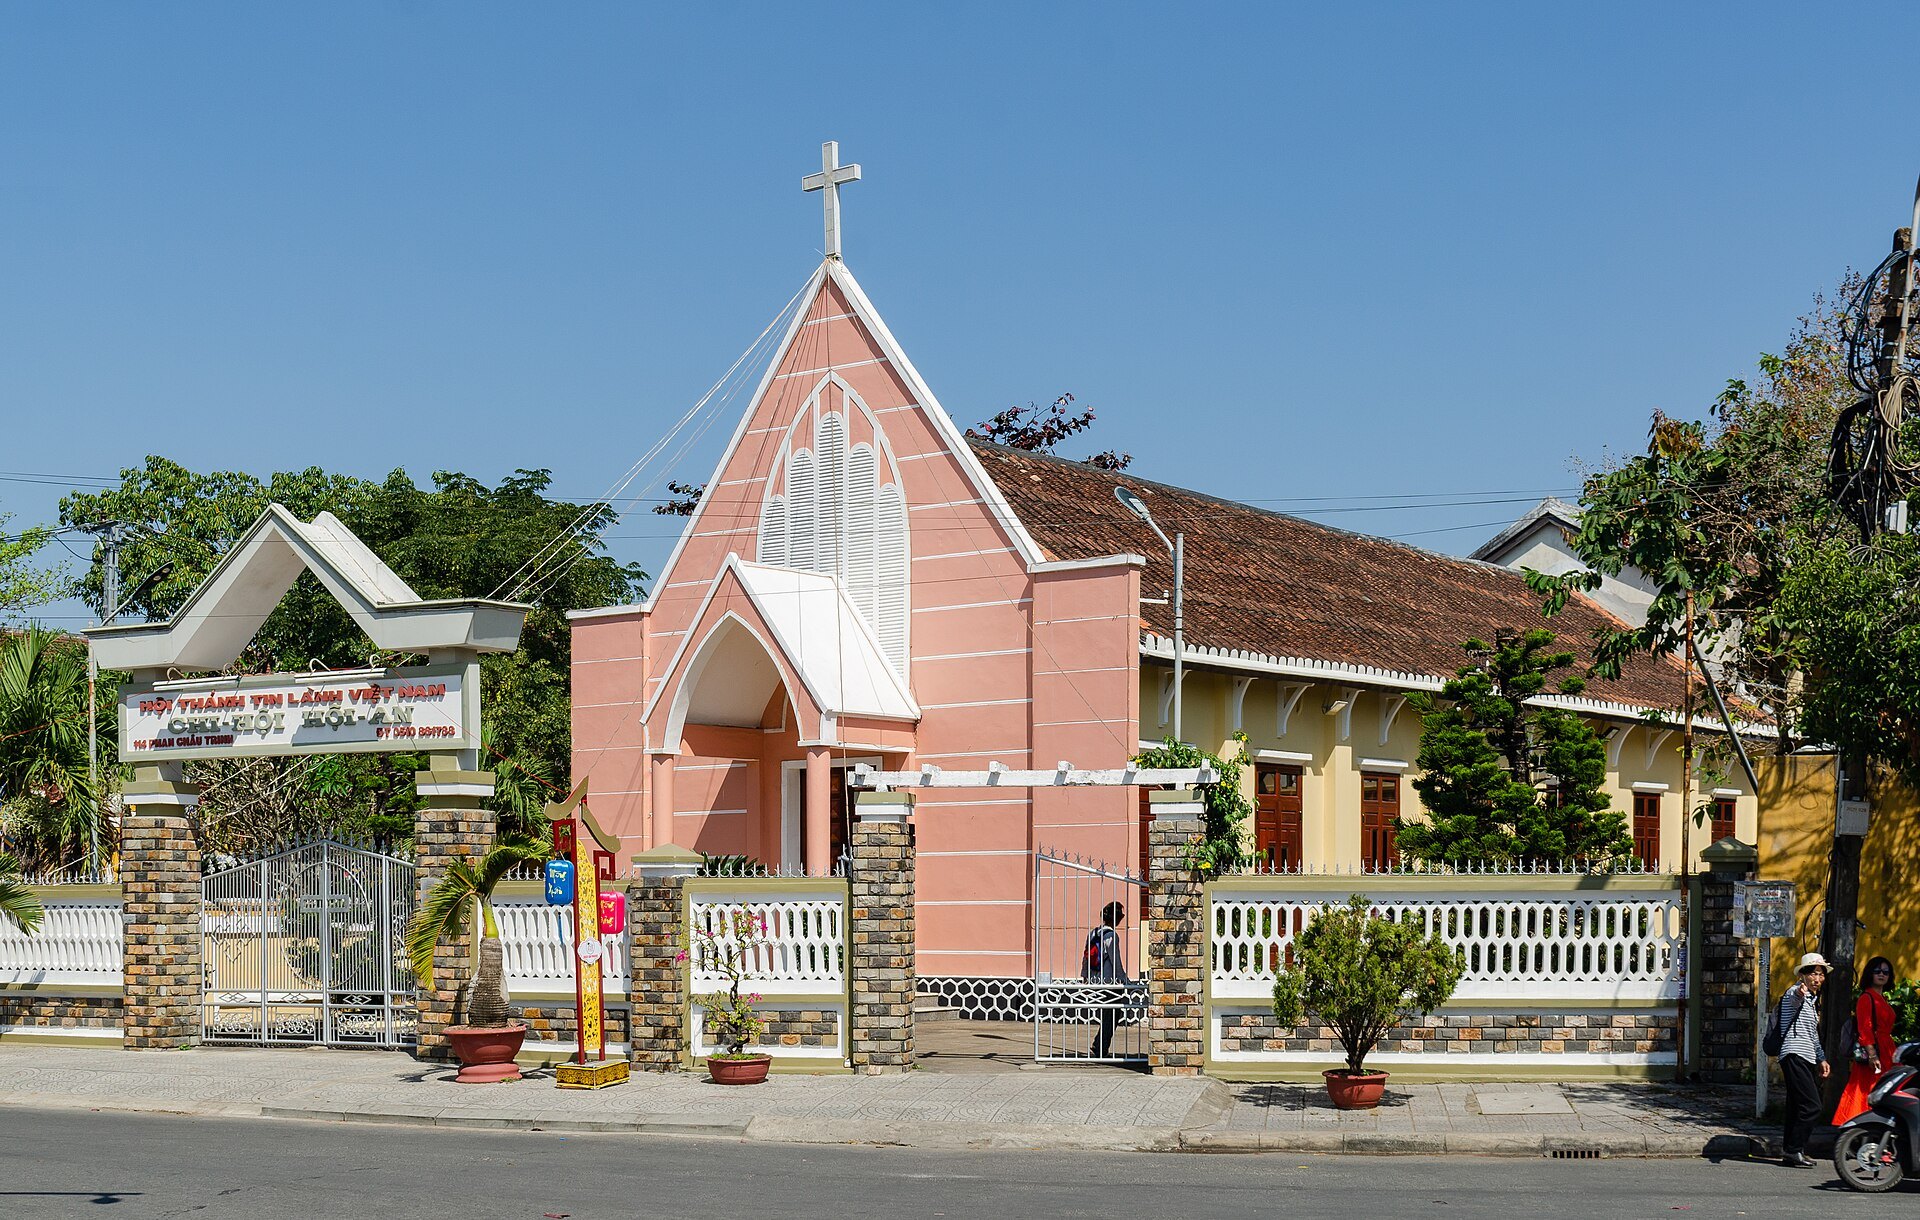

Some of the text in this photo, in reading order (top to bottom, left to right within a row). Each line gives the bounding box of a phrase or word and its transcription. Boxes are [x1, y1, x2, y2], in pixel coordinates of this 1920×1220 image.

[139, 697, 172, 715] HỘI
[178, 689, 246, 710] THÁNH
[250, 693, 283, 707] TIN
[348, 684, 394, 704] VIỆT
[397, 684, 446, 698] NAM
[149, 737, 175, 749] PHAN
